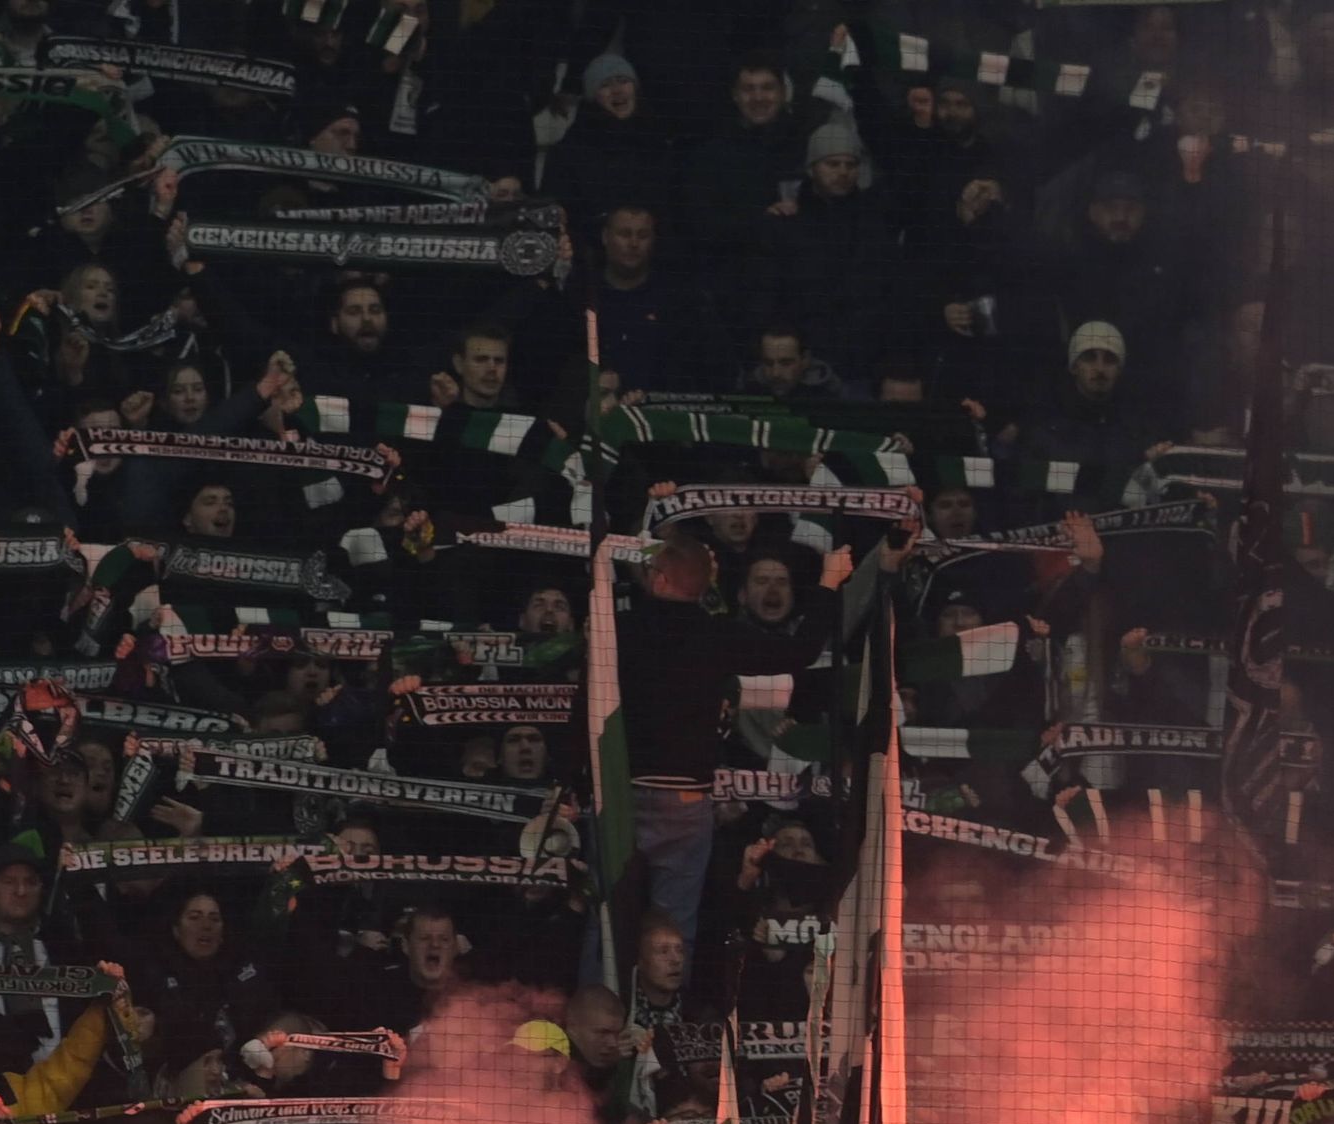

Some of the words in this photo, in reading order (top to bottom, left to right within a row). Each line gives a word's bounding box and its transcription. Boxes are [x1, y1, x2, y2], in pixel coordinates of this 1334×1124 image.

[188, 227, 340, 255] GEMEINSAM
[378, 234, 498, 260] BORUSSIA
[198, 553, 301, 584] BORUSSIA
[214, 755, 517, 814] TRADITIONSVEREIN
